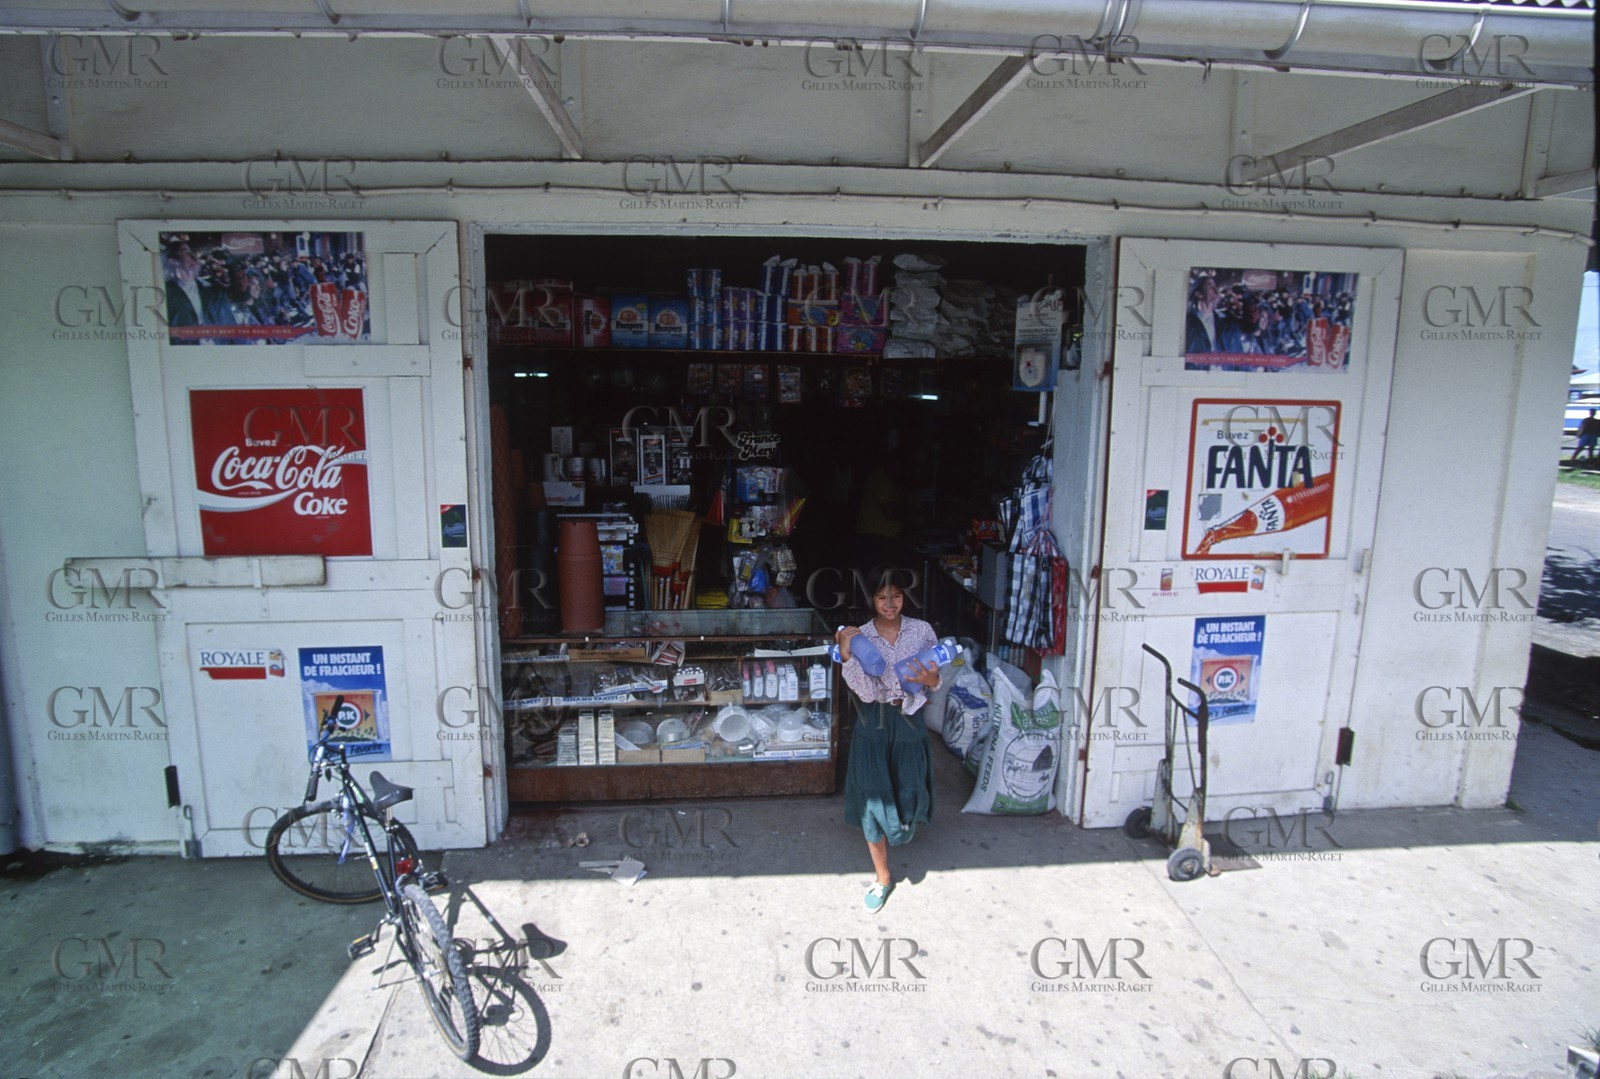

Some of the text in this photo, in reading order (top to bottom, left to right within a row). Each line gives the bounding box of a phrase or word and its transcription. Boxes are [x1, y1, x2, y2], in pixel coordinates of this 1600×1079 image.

[344, 298, 362, 334] Coke
[655, 323, 682, 333] Pampers
[738, 431, 781, 448] France
[1217, 430, 1249, 440] Buvez
[245, 438, 278, 446] Buvez
[211, 445, 344, 490] Coca-Cola
[1206, 444, 1313, 488] FANTA
[294, 492, 348, 515] Coke
[1260, 498, 1278, 532] FANTA
[1195, 567, 1249, 580] ROYALE
[1206, 622, 1256, 632] UN INSTANT
[1197, 634, 1208, 644] DE
[1210, 632, 1256, 644] FRAICHEUR
[200, 652, 265, 666] ROYALE
[313, 653, 370, 664] UN INSTANT
[304, 666, 318, 676] DE
[320, 664, 374, 676] FRAICHEUR
[350, 743, 382, 754] Favorite
[981, 756, 994, 792] FEEDS
